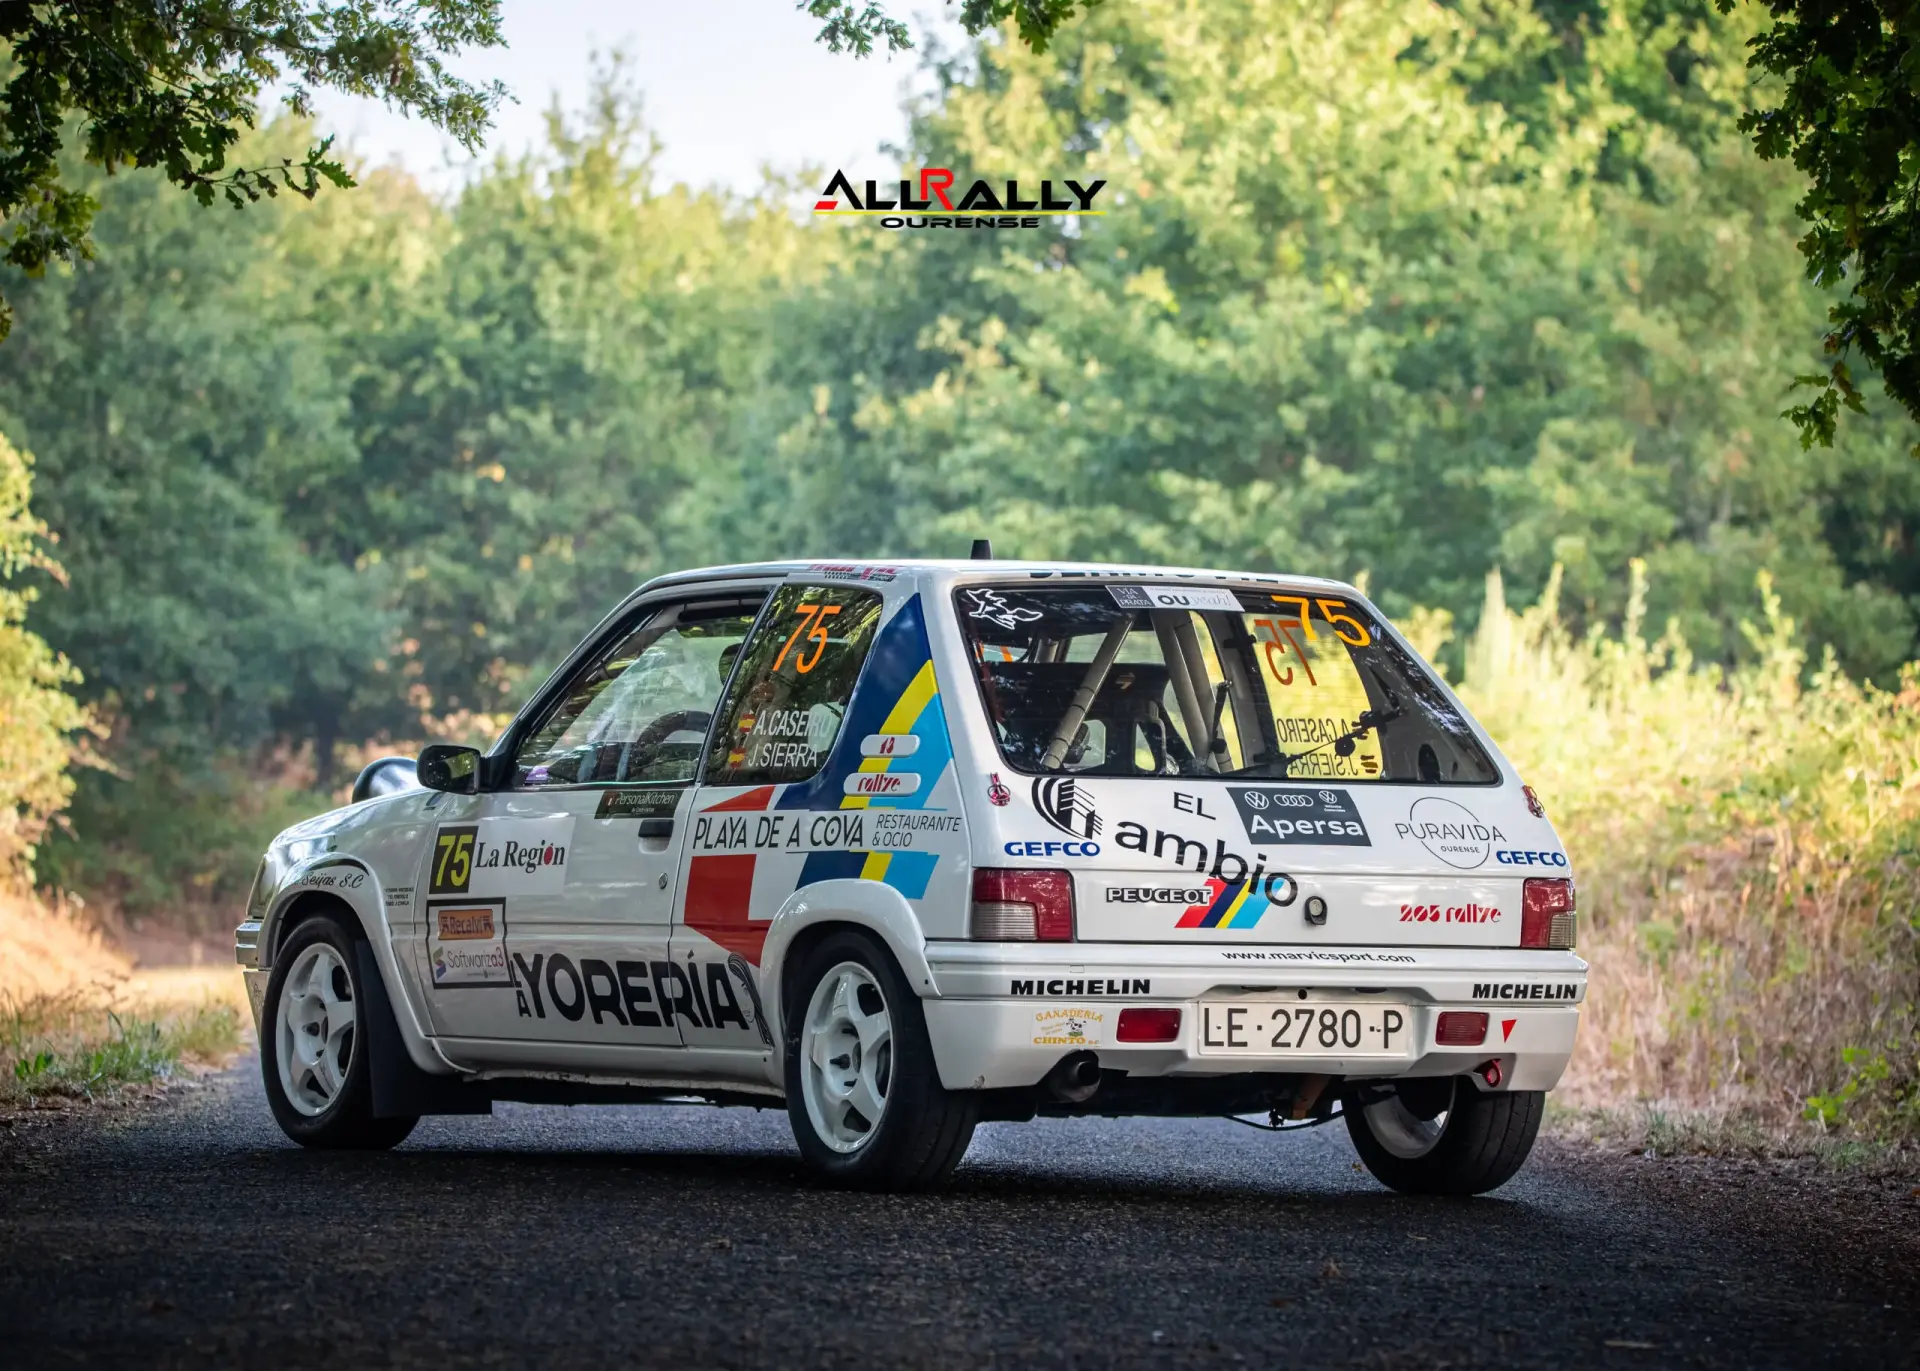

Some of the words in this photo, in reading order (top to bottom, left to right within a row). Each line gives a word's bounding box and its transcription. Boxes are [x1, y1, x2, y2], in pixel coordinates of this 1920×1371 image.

[1271, 595, 1371, 647] 75
[771, 605, 842, 674] 75
[747, 742, 817, 768] J.SIERRA
[1173, 791, 1217, 821] EL
[692, 817, 747, 849] PLAYA
[754, 816, 784, 848] DE
[786, 817, 800, 848] A
[810, 815, 864, 847] COVA
[876, 814, 962, 832] RESTAURANTE
[1250, 814, 1364, 839] Apersa
[882, 832, 913, 847] OCIO
[1395, 823, 1507, 842] PURAVIDA
[475, 842, 500, 868] La
[1003, 841, 1101, 856] GEFCO
[1440, 845, 1480, 854] OURENSE
[435, 834, 474, 887] 75
[1496, 850, 1567, 867] GEFCO
[1106, 888, 1213, 906] PEUGEOT
[1399, 904, 1440, 922] 205
[1445, 904, 1501, 922] rallye
[1221, 951, 1416, 963] www.marvicsport.com
[1011, 980, 1151, 996] MICHELIN
[1472, 983, 1578, 999] MICHELIN
[1033, 1036, 1087, 1045] CHINTO
